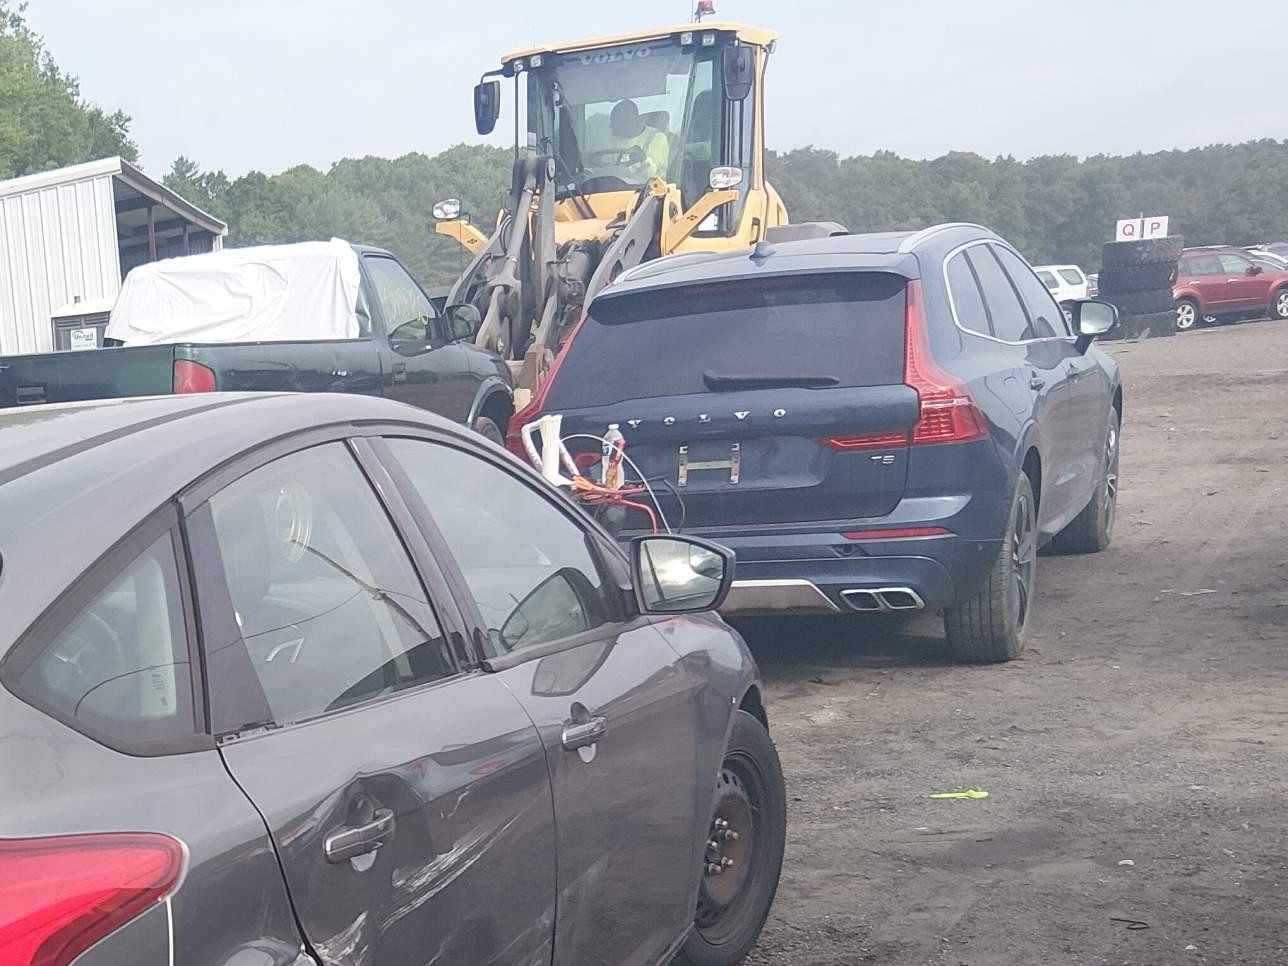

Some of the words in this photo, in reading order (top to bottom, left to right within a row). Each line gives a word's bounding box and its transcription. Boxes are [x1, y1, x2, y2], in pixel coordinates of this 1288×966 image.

[579, 45, 651, 66] VOLVO
[1122, 223, 1135, 237] Q
[1150, 222, 1161, 235] P
[627, 407, 787, 429] VOLVO
